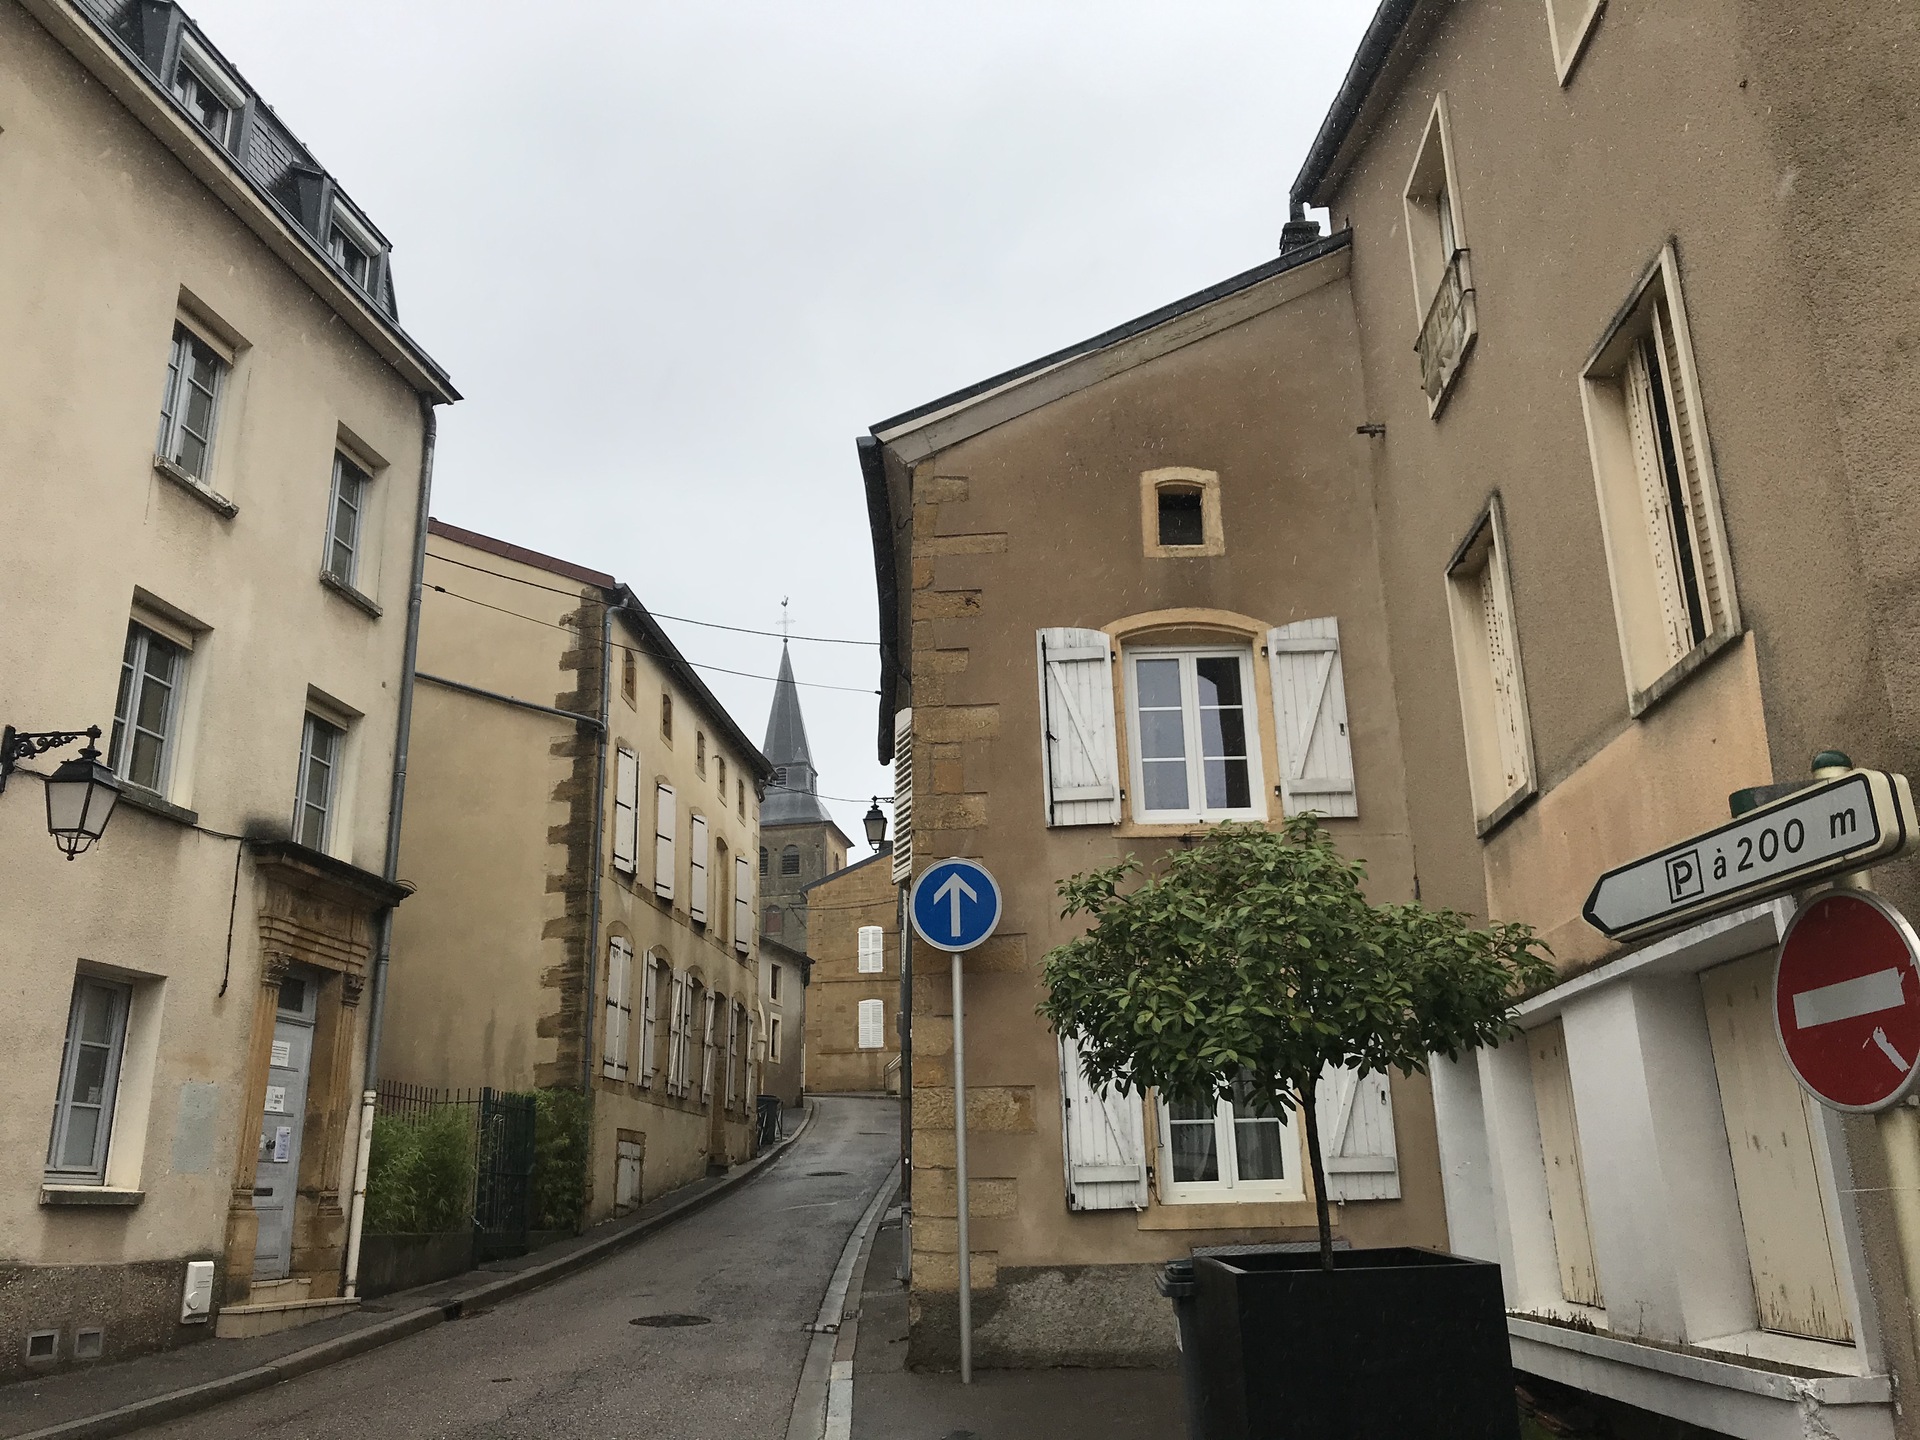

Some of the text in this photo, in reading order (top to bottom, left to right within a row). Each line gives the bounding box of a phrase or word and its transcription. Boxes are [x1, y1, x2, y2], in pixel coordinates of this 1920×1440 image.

[1672, 806, 1857, 896] P à 200 m
